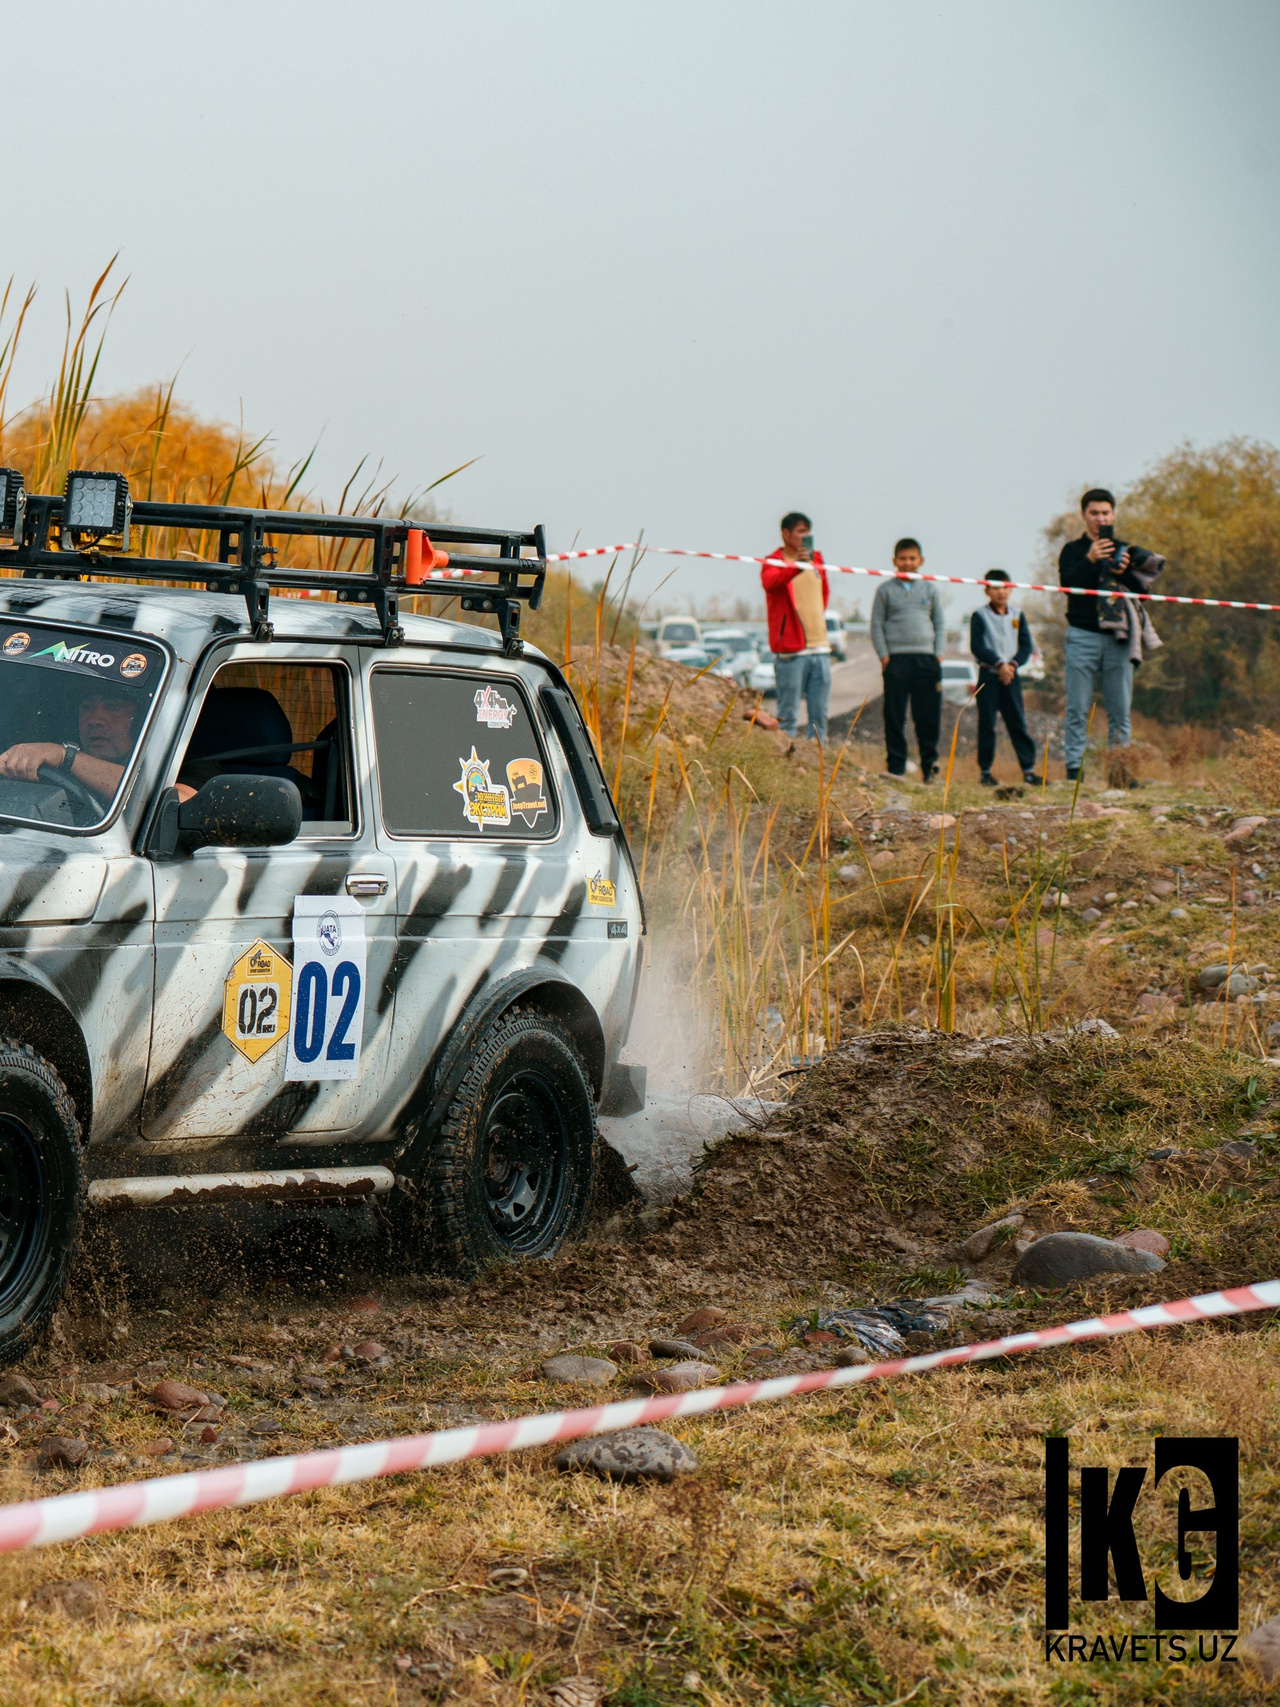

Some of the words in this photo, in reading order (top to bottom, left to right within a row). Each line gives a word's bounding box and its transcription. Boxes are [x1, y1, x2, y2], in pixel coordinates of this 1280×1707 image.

[57, 646, 115, 667] NITRO
[478, 709, 510, 720] ENERGY
[476, 790, 505, 802] ЮЖНЫЙ
[469, 801, 508, 819] ЭКСТРИМ
[238, 986, 277, 1034] 02
[294, 961, 361, 1064] 02
